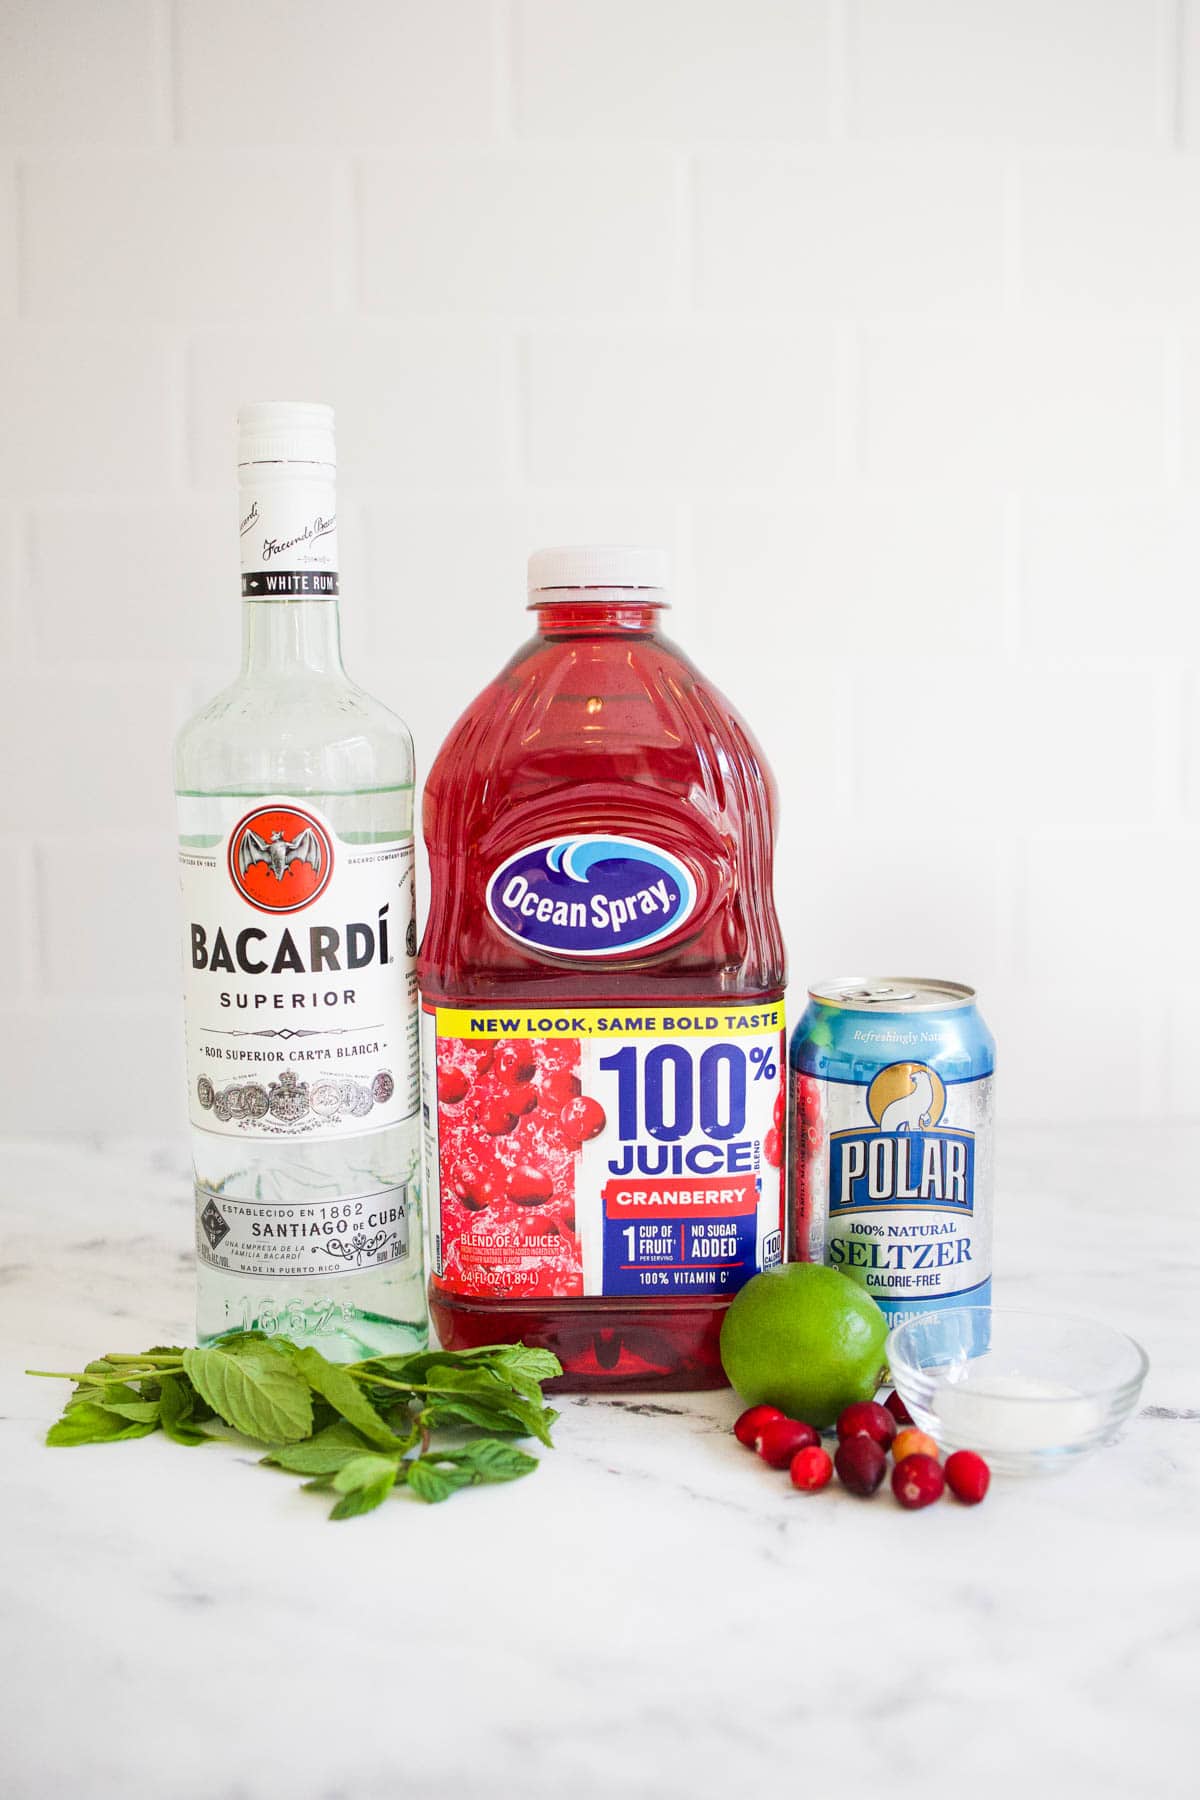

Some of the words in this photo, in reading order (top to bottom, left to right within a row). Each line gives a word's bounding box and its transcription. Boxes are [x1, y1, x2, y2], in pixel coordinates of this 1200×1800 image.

[266, 576, 309, 590] WHITE
[313, 576, 333, 590] RUM
[502, 875, 587, 928] Ocean
[191, 902, 389, 974] BACARDÍ
[220, 990, 356, 1009] SUPERIOR
[470, 1017, 520, 1032] NEW
[527, 1017, 592, 1033] LOOK,
[597, 1017, 656, 1031] SAME
[662, 1016, 719, 1030] BOLD
[725, 1011, 779, 1029] TASTE
[854, 1030, 918, 1045] Refreshingly
[205, 1046, 223, 1059] RON
[225, 1049, 285, 1062] SUPERIOR
[289, 1049, 332, 1061] CARTA
[337, 1042, 379, 1058] BLANCA
[600, 1043, 777, 1142] 100%
[608, 1141, 752, 1175] JUICE
[753, 1139, 761, 1170] BLEND
[840, 1138, 967, 1204] POLAR
[616, 1187, 747, 1206] CRANBERRY
[222, 1204, 294, 1218] ESTABLECIDO
[300, 1209, 314, 1217] EN
[320, 1203, 363, 1219] 1862
[252, 1219, 348, 1237] SANTIAGO
[353, 1222, 364, 1231] DE
[368, 1205, 405, 1227] CUBA
[850, 1223, 884, 1236] 100%
[888, 1222, 957, 1237] NATURAL
[640, 1225, 658, 1238] CUP
[661, 1225, 673, 1237] OF
[691, 1225, 705, 1237] NO
[707, 1224, 737, 1237] SUGAR
[225, 1240, 239, 1248] UNA
[241, 1243, 277, 1252] EMPRESA
[461, 1233, 493, 1247] BLEND
[496, 1235, 510, 1247] OF
[513, 1235, 520, 1247] 4
[522, 1235, 560, 1247] JUICES
[622, 1226, 635, 1262] 1
[231, 1249, 260, 1258] FAMILIA
[829, 1238, 973, 1270] SELTZER
[240, 1264, 262, 1272] MADE
[318, 1264, 340, 1273] RICO
[461, 1271, 473, 1282] 64
[475, 1272, 485, 1284] FL
[487, 1272, 500, 1285] OZ
[502, 1272, 528, 1285] (1.89
[640, 1272, 669, 1285] 100%
[674, 1271, 716, 1284] VITAMIN
[866, 1273, 941, 1287] CALORIE-FREE
